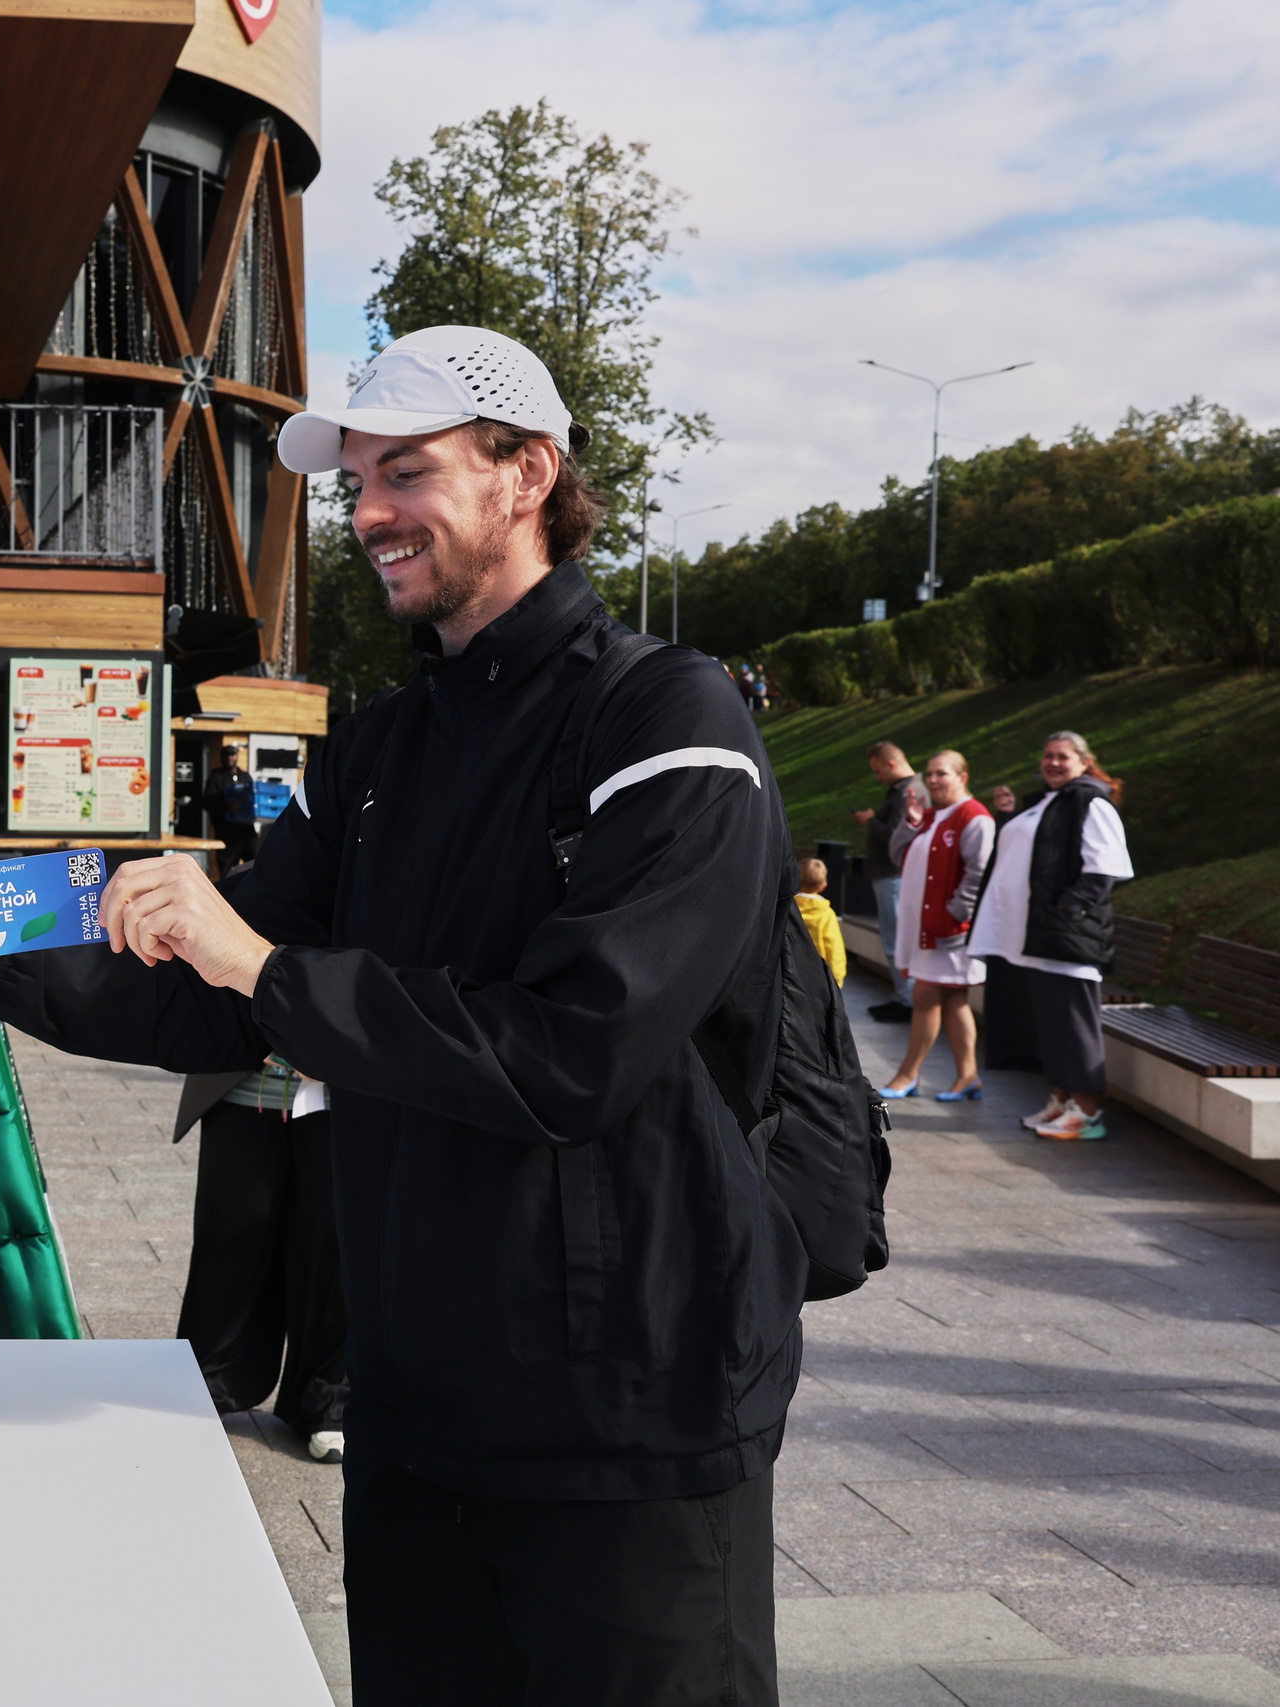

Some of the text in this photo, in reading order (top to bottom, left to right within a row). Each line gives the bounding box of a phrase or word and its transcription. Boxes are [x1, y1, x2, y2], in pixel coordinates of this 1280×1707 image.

[79, 894, 91, 940] БУДЬ НА
[88, 892, 102, 939] ВЫСОТЕ!
